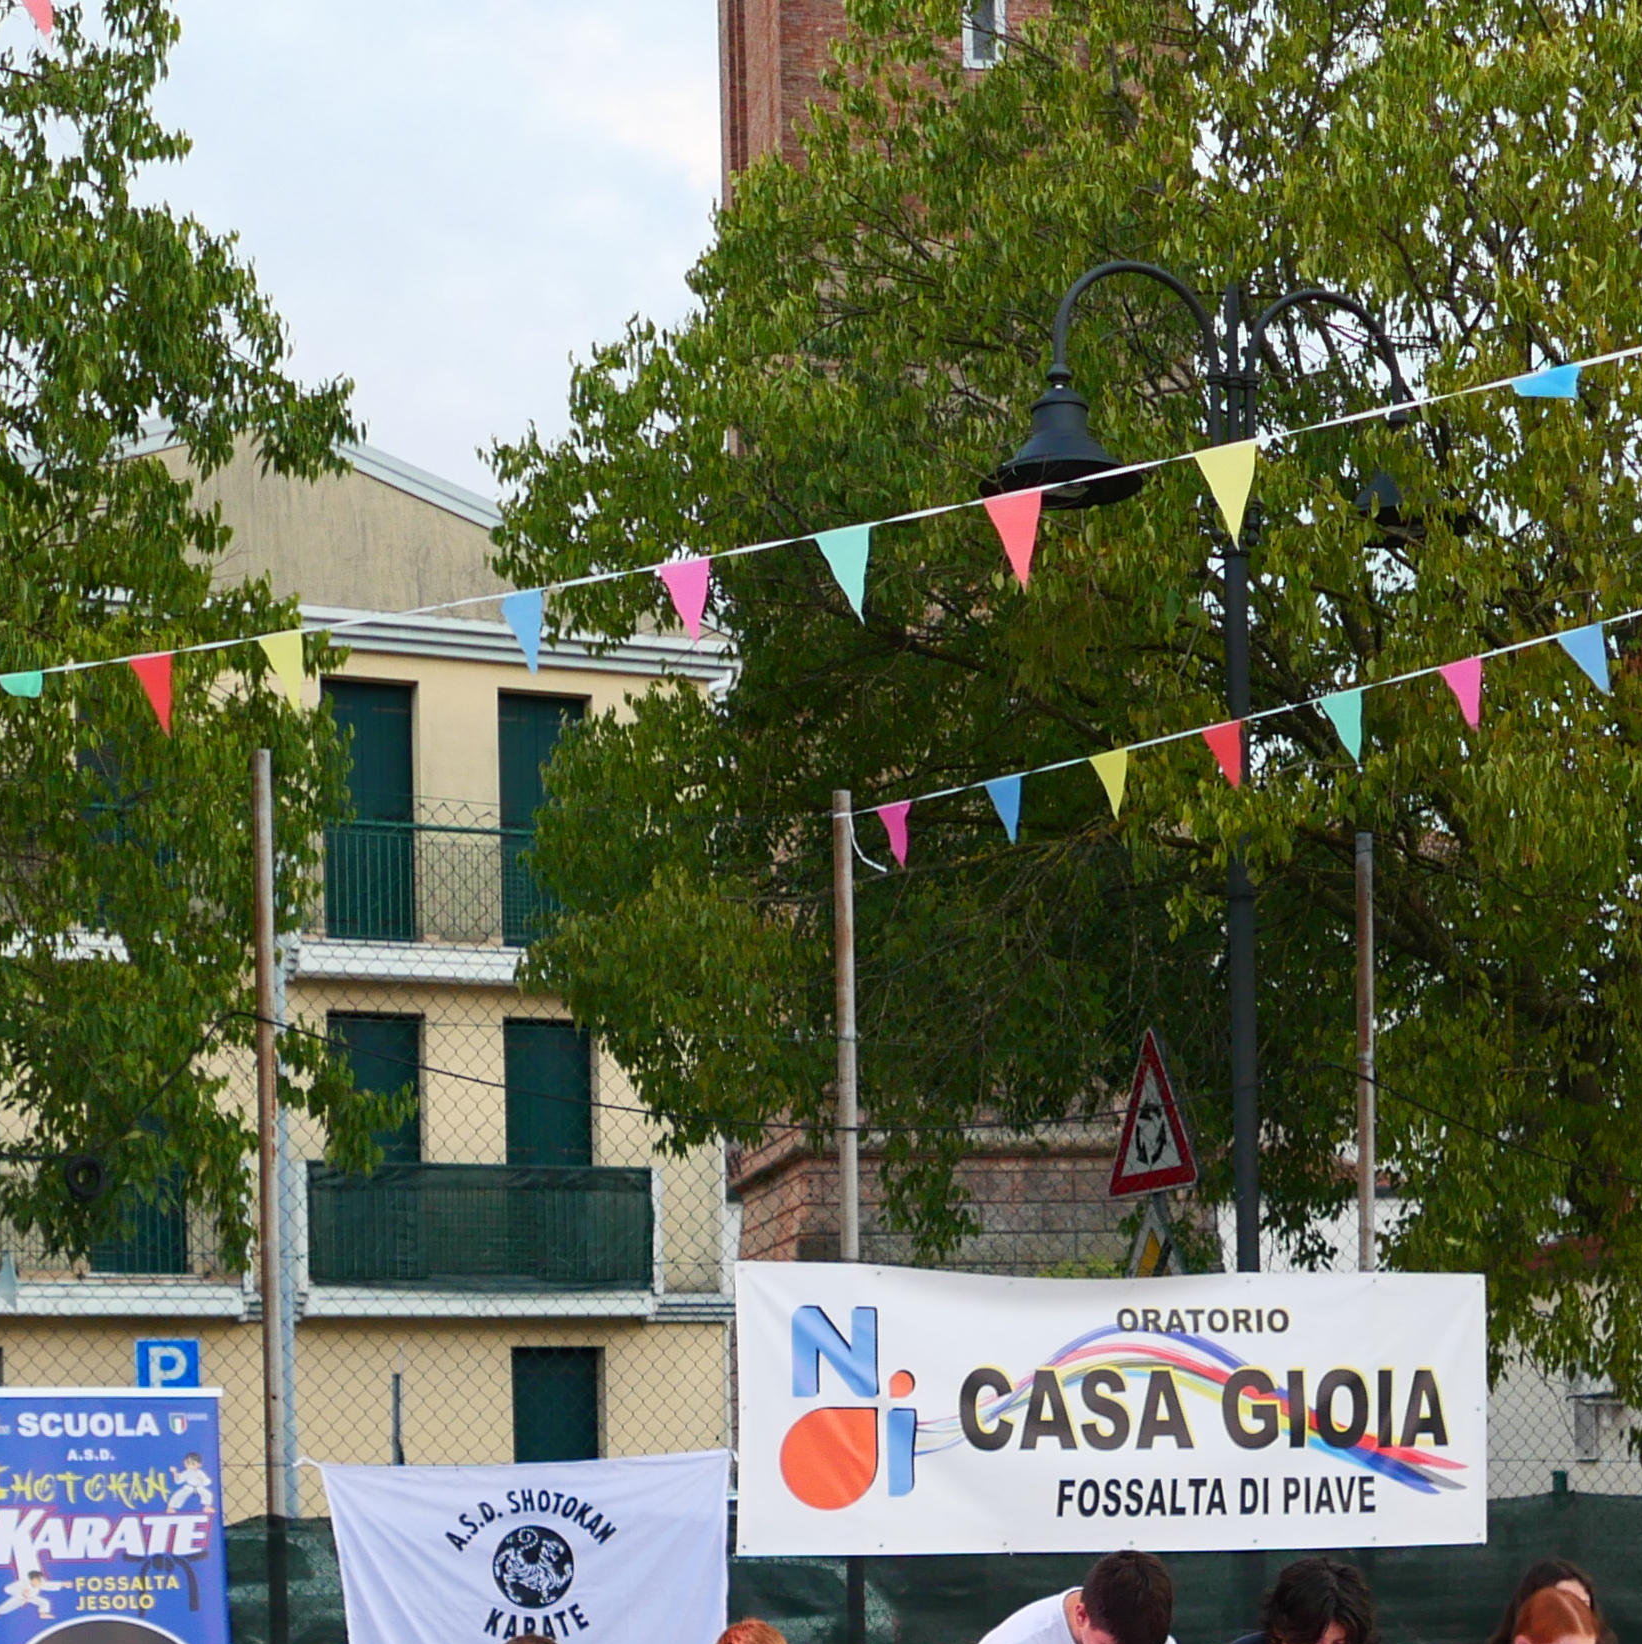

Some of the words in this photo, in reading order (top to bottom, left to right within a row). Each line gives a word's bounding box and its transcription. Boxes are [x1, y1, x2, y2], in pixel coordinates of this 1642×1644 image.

[1116, 1307, 1291, 1334] ORATORIO
[148, 1345, 189, 1388] P
[17, 1412, 161, 1437] SCUOLA
[958, 1364, 1194, 1452] CASA
[1221, 1365, 1451, 1450] GIOIA
[67, 1449, 116, 1462] A.S.D.
[1057, 1476, 1227, 1518] FOSSALTA
[1240, 1477, 1271, 1516] DI
[1283, 1475, 1377, 1516] PIAVE
[445, 1501, 503, 1553] A.S.D.
[506, 1488, 617, 1546] SHOTOKAN
[74, 1575, 180, 1592] FOSSALTA
[75, 1594, 156, 1612] JESOLO
[483, 1602, 590, 1641] KARATE
